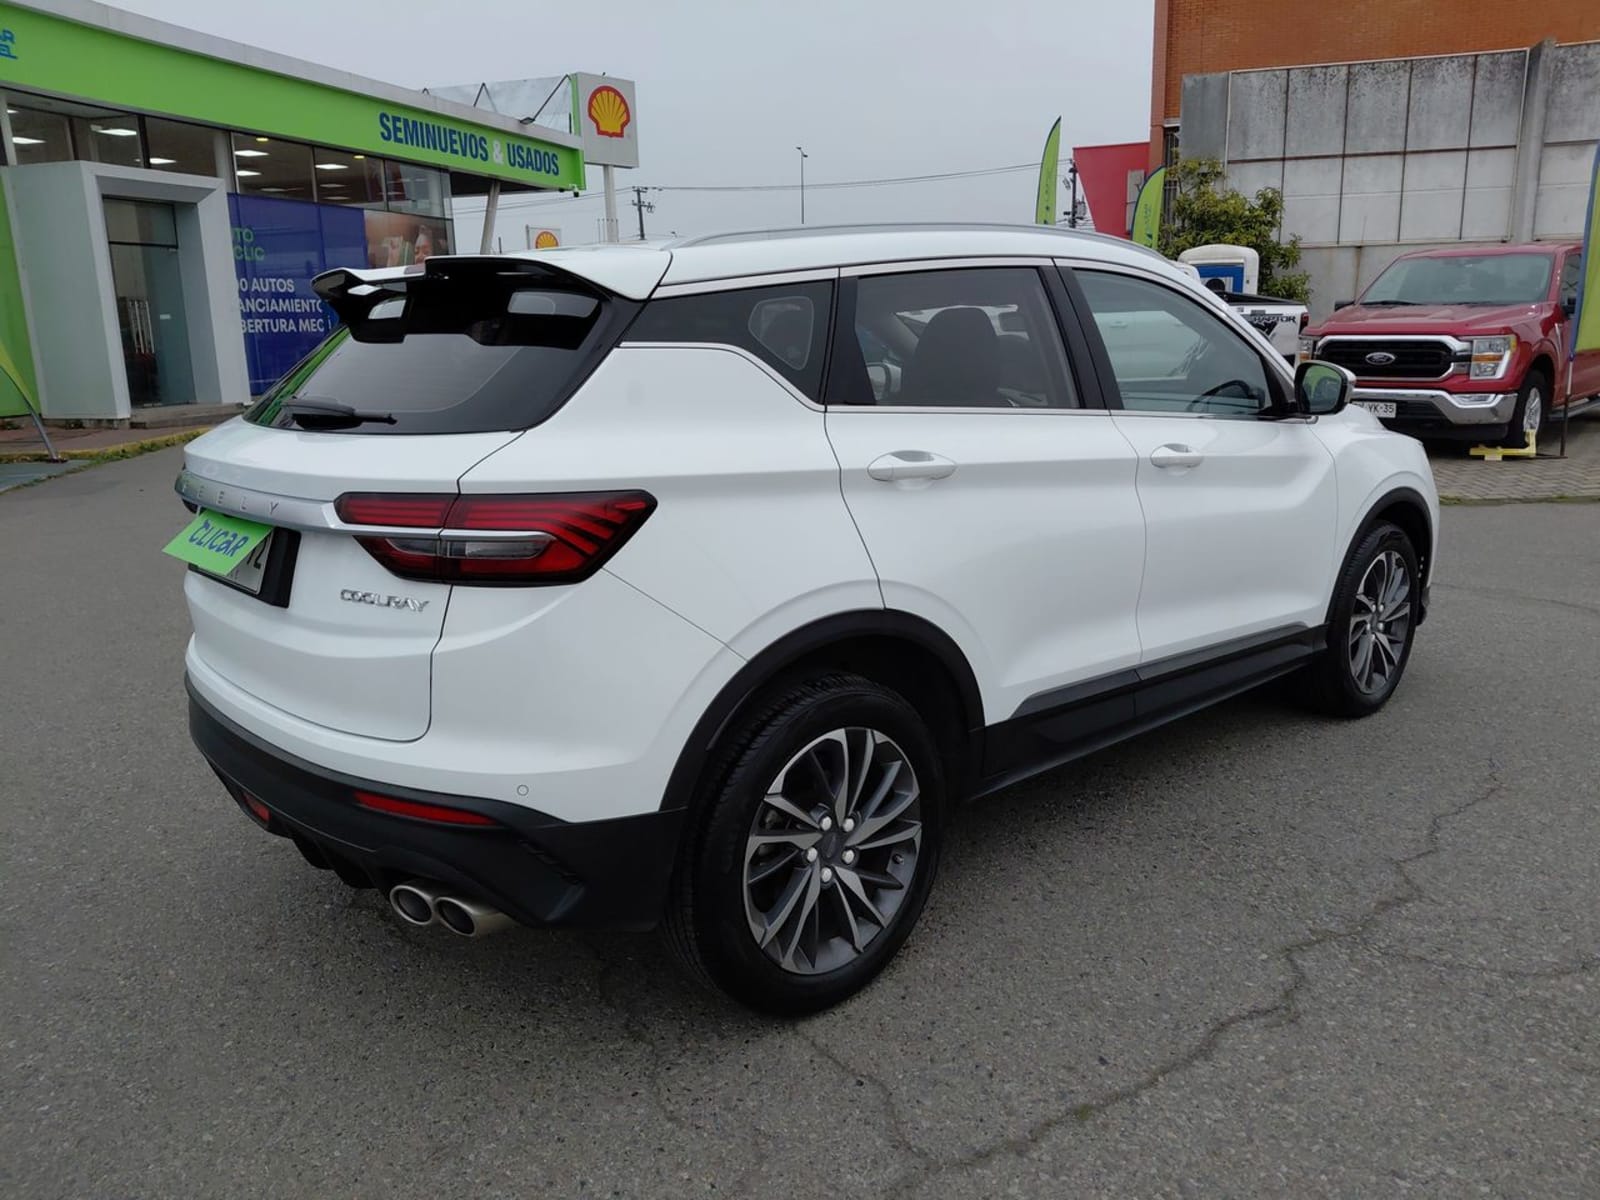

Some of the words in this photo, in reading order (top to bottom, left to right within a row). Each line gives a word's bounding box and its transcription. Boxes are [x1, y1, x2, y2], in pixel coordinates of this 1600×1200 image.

[379, 112, 489, 161] SEMINUEVOS
[493, 139, 504, 163] &
[507, 142, 560, 176] USADOS
[251, 278, 295, 293] AUTOS
[341, 588, 431, 613] COOLRAY
